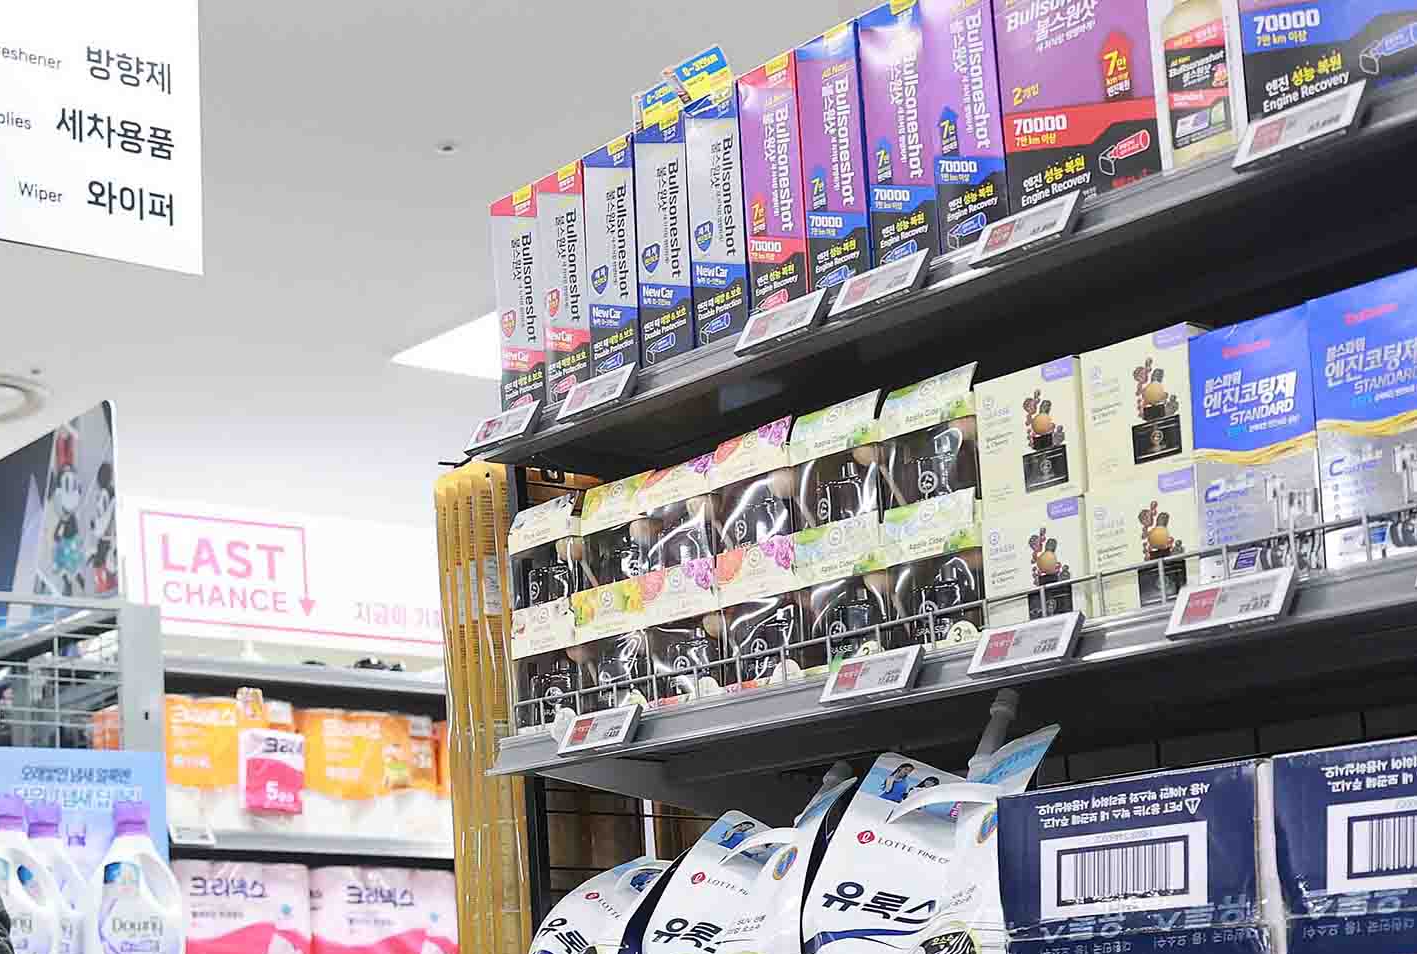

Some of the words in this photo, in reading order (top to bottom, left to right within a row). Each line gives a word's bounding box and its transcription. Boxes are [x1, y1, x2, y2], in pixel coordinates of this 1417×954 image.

[1254, 8, 1320, 34] 70000
[86, 45, 172, 95] 방향제
[966, 9, 990, 149] Bullsoneshot
[1265, 75, 1289, 96] 엔진
[1291, 62, 1315, 85] 성능
[1263, 91, 1299, 113] Engine
[1301, 71, 1350, 98] Recovery
[56, 108, 174, 160] 세차용품
[835, 75, 855, 206] Bullsoneshot
[1013, 114, 1068, 136] 70000
[775, 104, 794, 232] Bullsoneshot
[939, 161, 977, 172] 70000
[1022, 173, 1043, 193] 엔진
[18, 180, 63, 203] Wiper
[87, 180, 174, 227] 와이퍼
[723, 136, 736, 258] Bullsoneshot
[874, 189, 910, 201] 70000
[1021, 187, 1051, 208] Engine
[1052, 171, 1091, 195] Recovery
[668, 158, 682, 279] Bullsoneshot
[809, 215, 842, 228] 70000
[616, 183, 630, 299] Bullsoneshot
[750, 240, 781, 253] 70000
[1203, 370, 1297, 418] 엔진코팅제
[1230, 399, 1294, 426] STANDARD
[160, 533, 284, 581] LAST
[163, 581, 289, 614] CHANCE
[1133, 803, 1161, 817] 용기는
[1163, 802, 1183, 814] PET
[878, 837, 915, 853] LOTTE
[822, 881, 937, 924] 유록스
